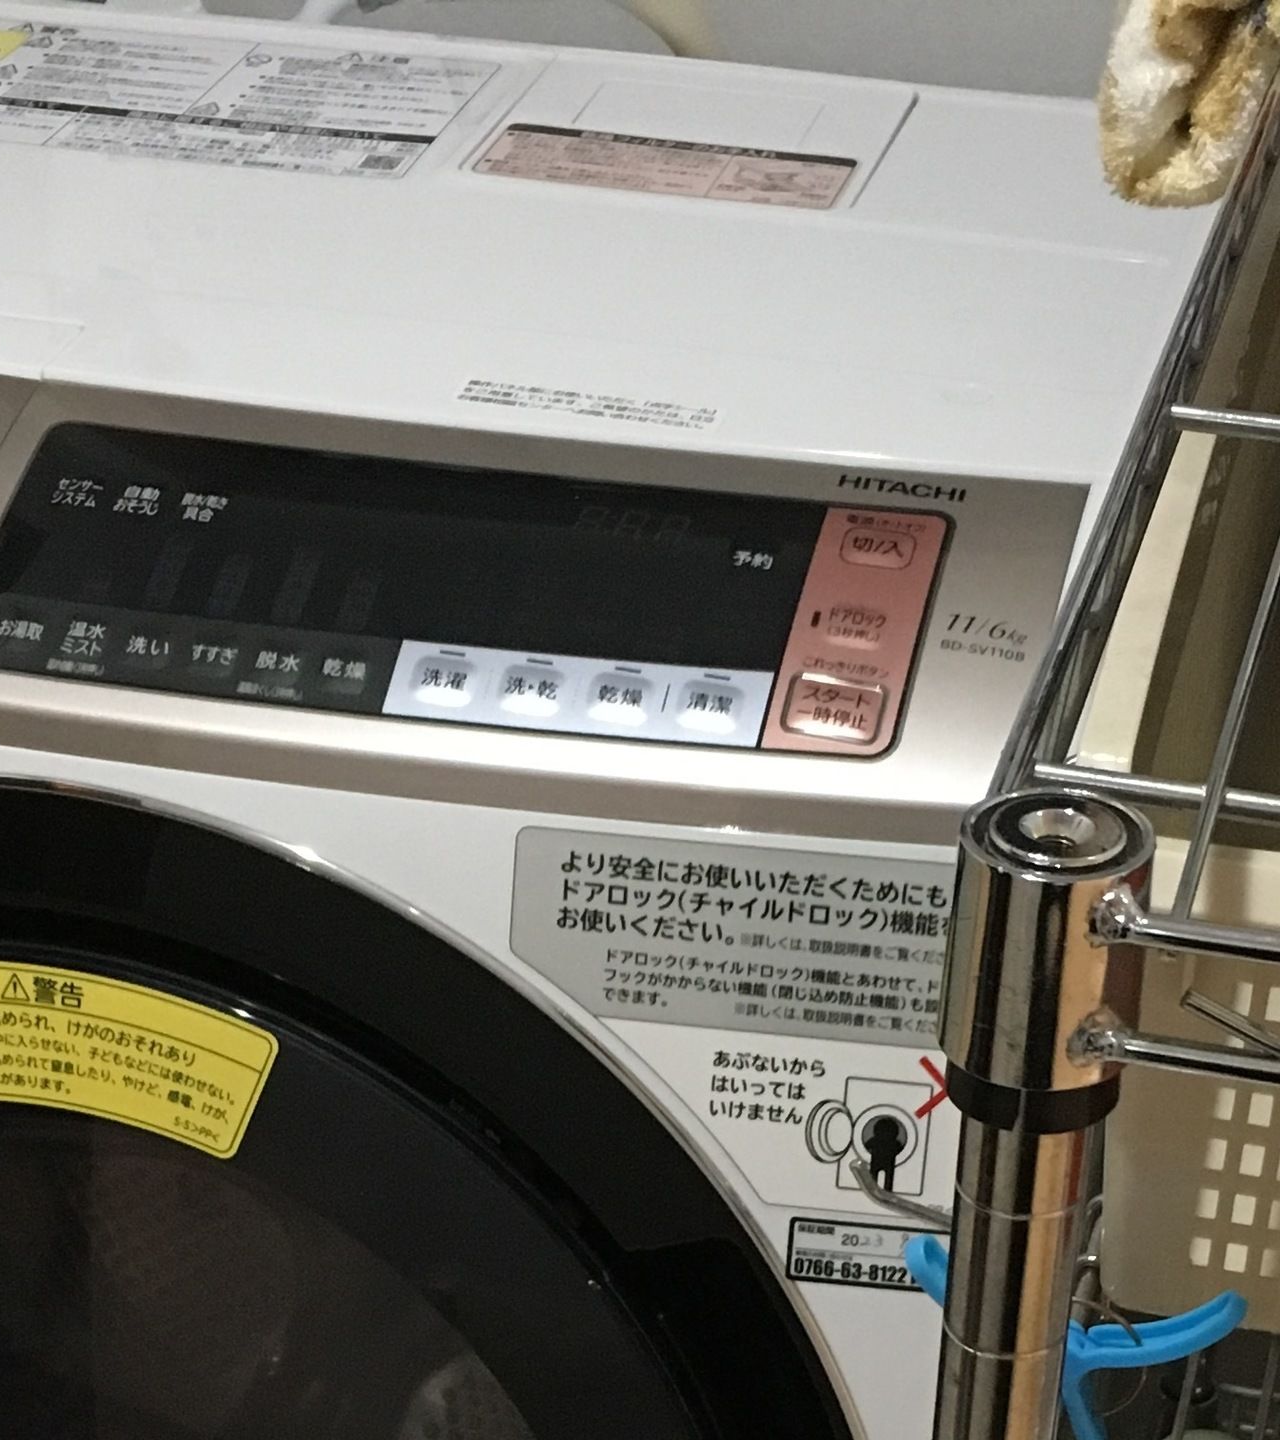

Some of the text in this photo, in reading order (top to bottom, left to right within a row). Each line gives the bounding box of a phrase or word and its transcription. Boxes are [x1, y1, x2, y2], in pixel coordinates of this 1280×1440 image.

[59, 478, 104, 492] センサー
[837, 474, 967, 502] HITACHI
[51, 490, 96, 507] システム
[733, 550, 773, 570] 予約
[828, 607, 887, 628] ドアロック
[68, 620, 106, 639] 温水
[60, 636, 102, 656] ミスト
[125, 635, 169, 655] 洗い
[192, 644, 238, 665] すすぎ
[255, 651, 300, 672] 脱水
[322, 658, 367, 681] 乾燥
[420, 667, 467, 691] 洗濯
[598, 684, 643, 707] 乾燥
[802, 684, 871, 709] スタート
[796, 705, 868, 730] 一時停止
[561, 850, 947, 908] より安全にお使いいただくためにも
[556, 906, 734, 946] お使いください。
[32, 975, 84, 1009] 警告
[712, 1050, 826, 1078] あぶないから
[710, 1074, 806, 1101] はいっては
[708, 1099, 804, 1125] いけません
